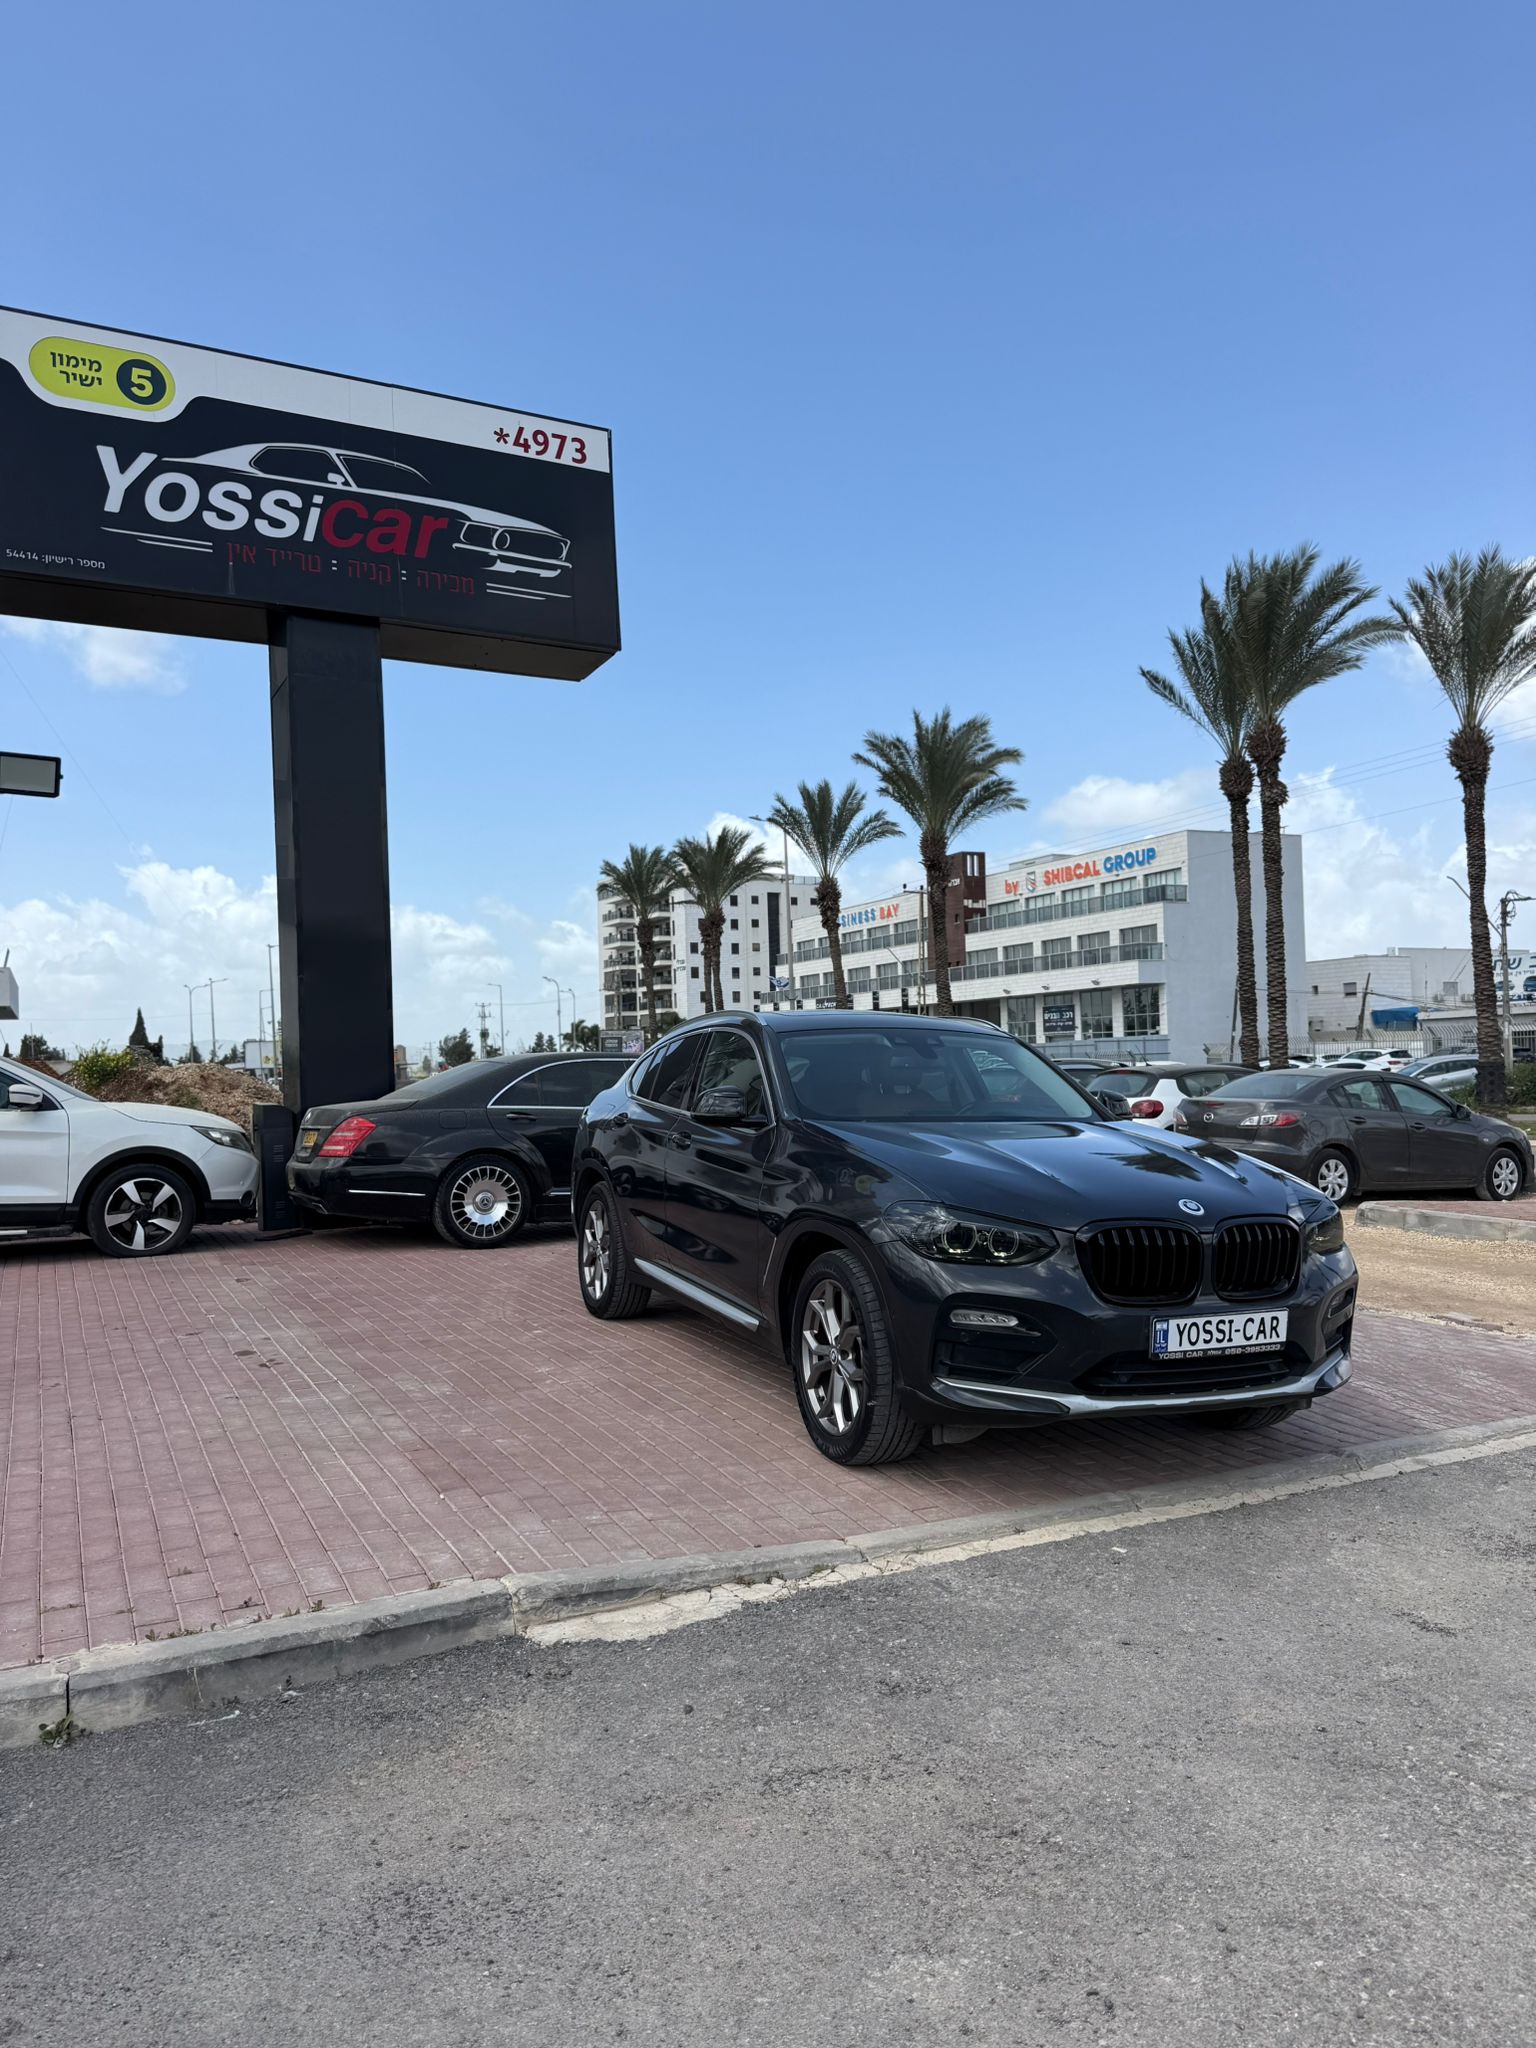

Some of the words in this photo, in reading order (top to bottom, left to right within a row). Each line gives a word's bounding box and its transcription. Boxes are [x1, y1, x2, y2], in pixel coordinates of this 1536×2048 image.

[50, 351, 103, 373] מימון
[59, 370, 103, 387] ישיר
[130, 367, 154, 398] 5
[6, 548, 39, 561] 54414
[76, 558, 106, 569] מספר
[226, 542, 257, 565] אין
[265, 547, 321, 573] טרייד
[348, 559, 392, 585] קניה
[416, 569, 475, 594] מכירה
[1004, 879, 1020, 896] by
[1103, 847, 1158, 873] GROUP
[838, 908, 877, 928] SINESS
[880, 903, 900, 920] BAY
[1156, 1330, 1166, 1343] IL
[1176, 1316, 1280, 1347] YOSSI-CAR
[1158, 1351, 1184, 1360] YOSSI
[1186, 1351, 1204, 1359] CAR
